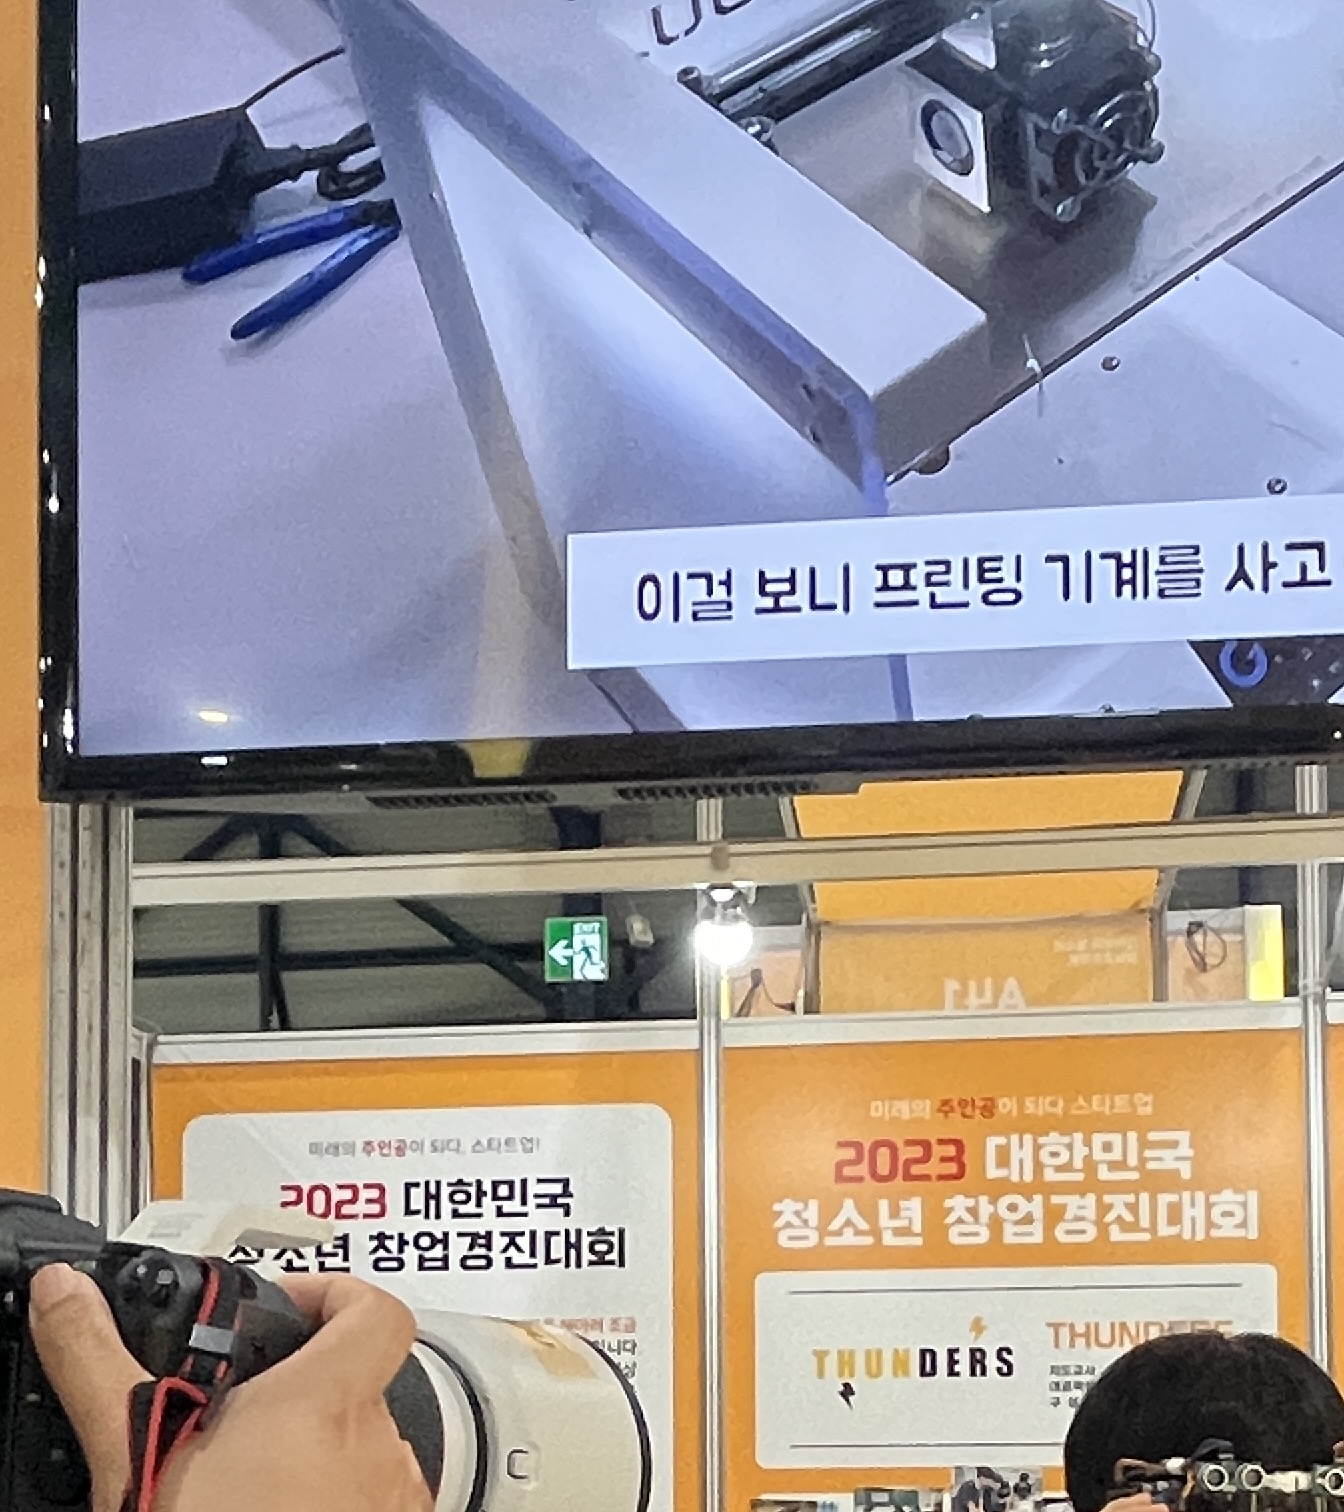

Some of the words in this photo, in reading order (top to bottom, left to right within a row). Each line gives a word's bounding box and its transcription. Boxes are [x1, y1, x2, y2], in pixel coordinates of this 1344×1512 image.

[637, 569, 734, 624] 이걸
[752, 564, 854, 618] 보니
[872, 555, 1024, 614] 프린팅
[1046, 542, 1205, 607] 기계를
[1224, 537, 1334, 595] 사고
[870, 1098, 931, 1121] 미래의
[936, 1095, 1017, 1120] 주인공이
[1024, 1094, 1064, 1117] 되다
[1070, 1092, 1154, 1116] 스타트업
[362, 1137, 425, 1157] 주인공이
[834, 1138, 966, 1185] 2023
[985, 1129, 1195, 1183] 대한민국
[280, 1182, 387, 1220] 2023
[403, 1176, 574, 1220] 대한민국
[772, 1196, 924, 1249] 청소년
[942, 1189, 1260, 1245] 창업경진대회
[369, 1227, 626, 1273] 창업경진대회
[813, 1346, 1015, 1380] THUNDERS
